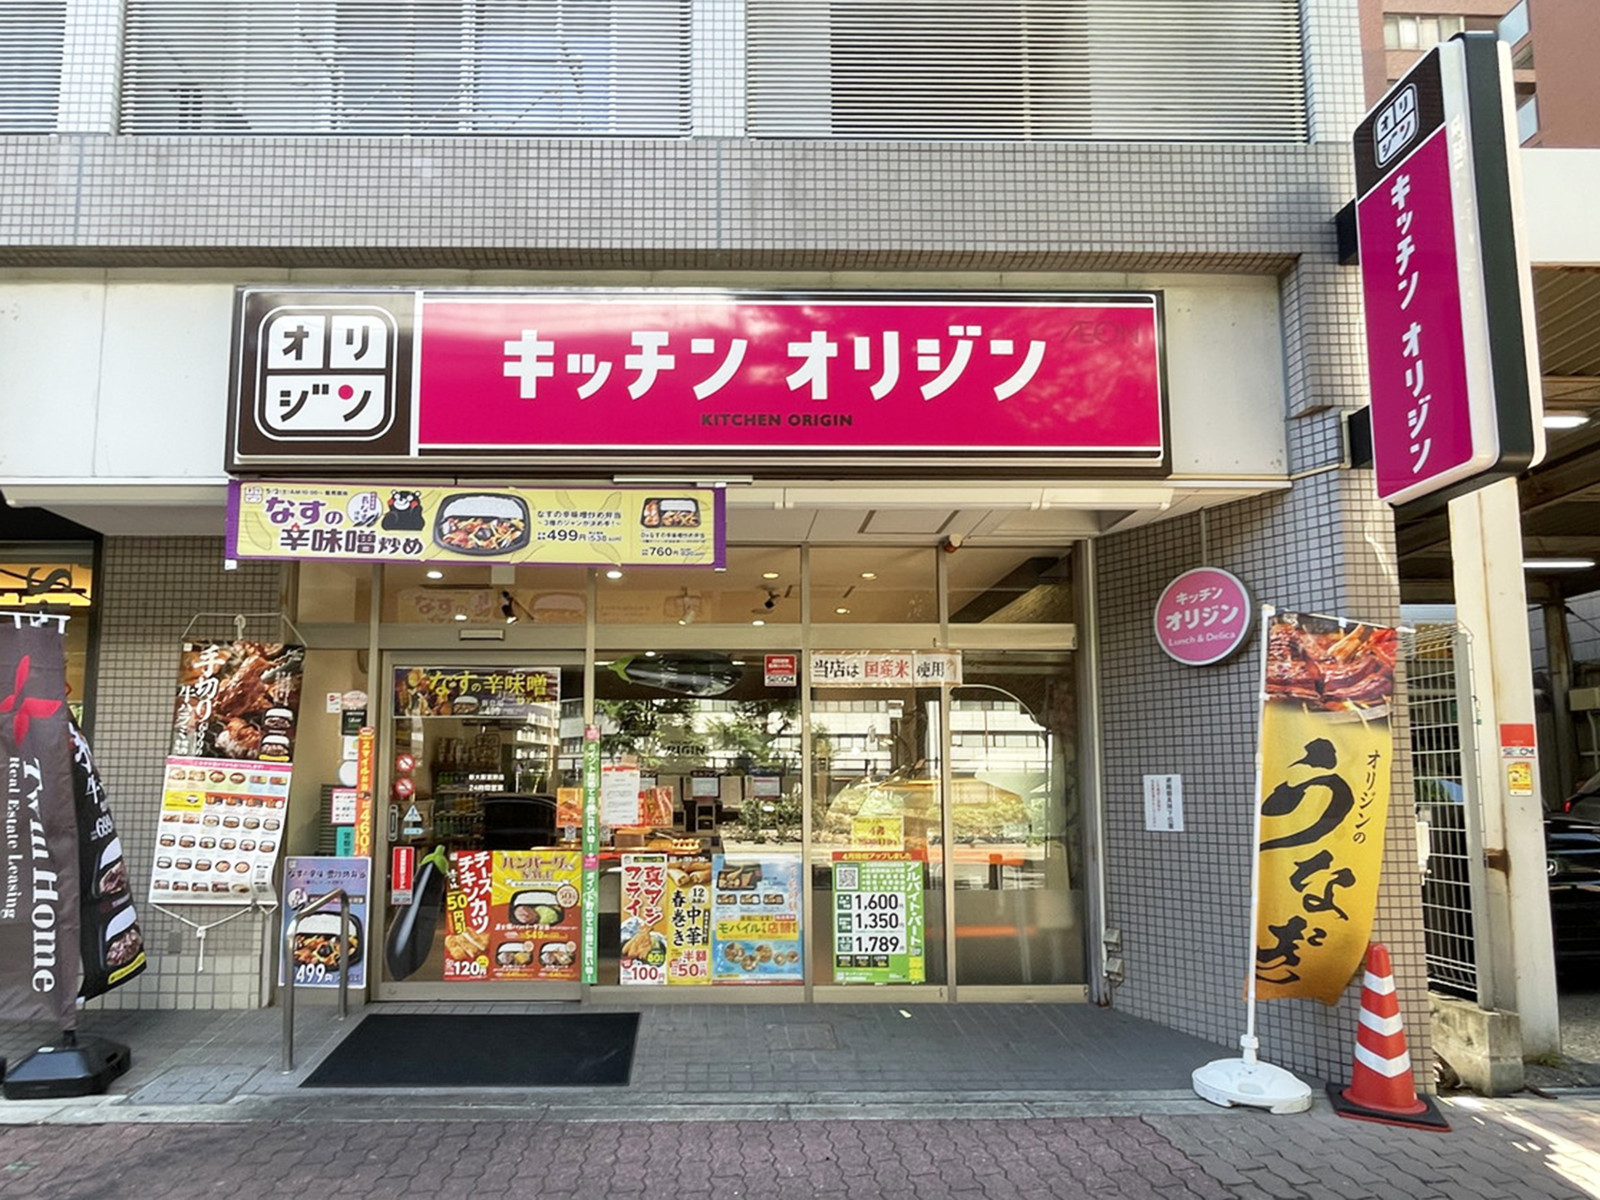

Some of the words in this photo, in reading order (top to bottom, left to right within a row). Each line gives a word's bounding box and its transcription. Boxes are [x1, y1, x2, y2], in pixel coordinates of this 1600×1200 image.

[1390, 173, 1420, 311] キッチン
[503, 329, 748, 401] キッチン
[785, 325, 1047, 402] オリジン
[1402, 321, 1432, 475] オリジン
[701, 413, 782, 427] KITCHEN
[787, 413, 853, 427] ORIGIN
[265, 496, 344, 527] なすの
[280, 525, 424, 555] 辛味噌炒め
[1176, 586, 1223, 606] キッチン
[1165, 604, 1239, 632] オリジン
[1168, 636, 1196, 647] Lunch
[1206, 631, 1237, 642] Delica
[428, 670, 548, 696] なすの辛味噌
[8, 757, 21, 794] Real
[1352, 749, 1381, 845] オリジンの
[5, 798, 20, 850] Estate
[1256, 737, 1357, 985] うなぎ
[1, 854, 24, 920] Leasing
[31, 867, 59, 993] Home
[686, 905, 703, 946] 中華
